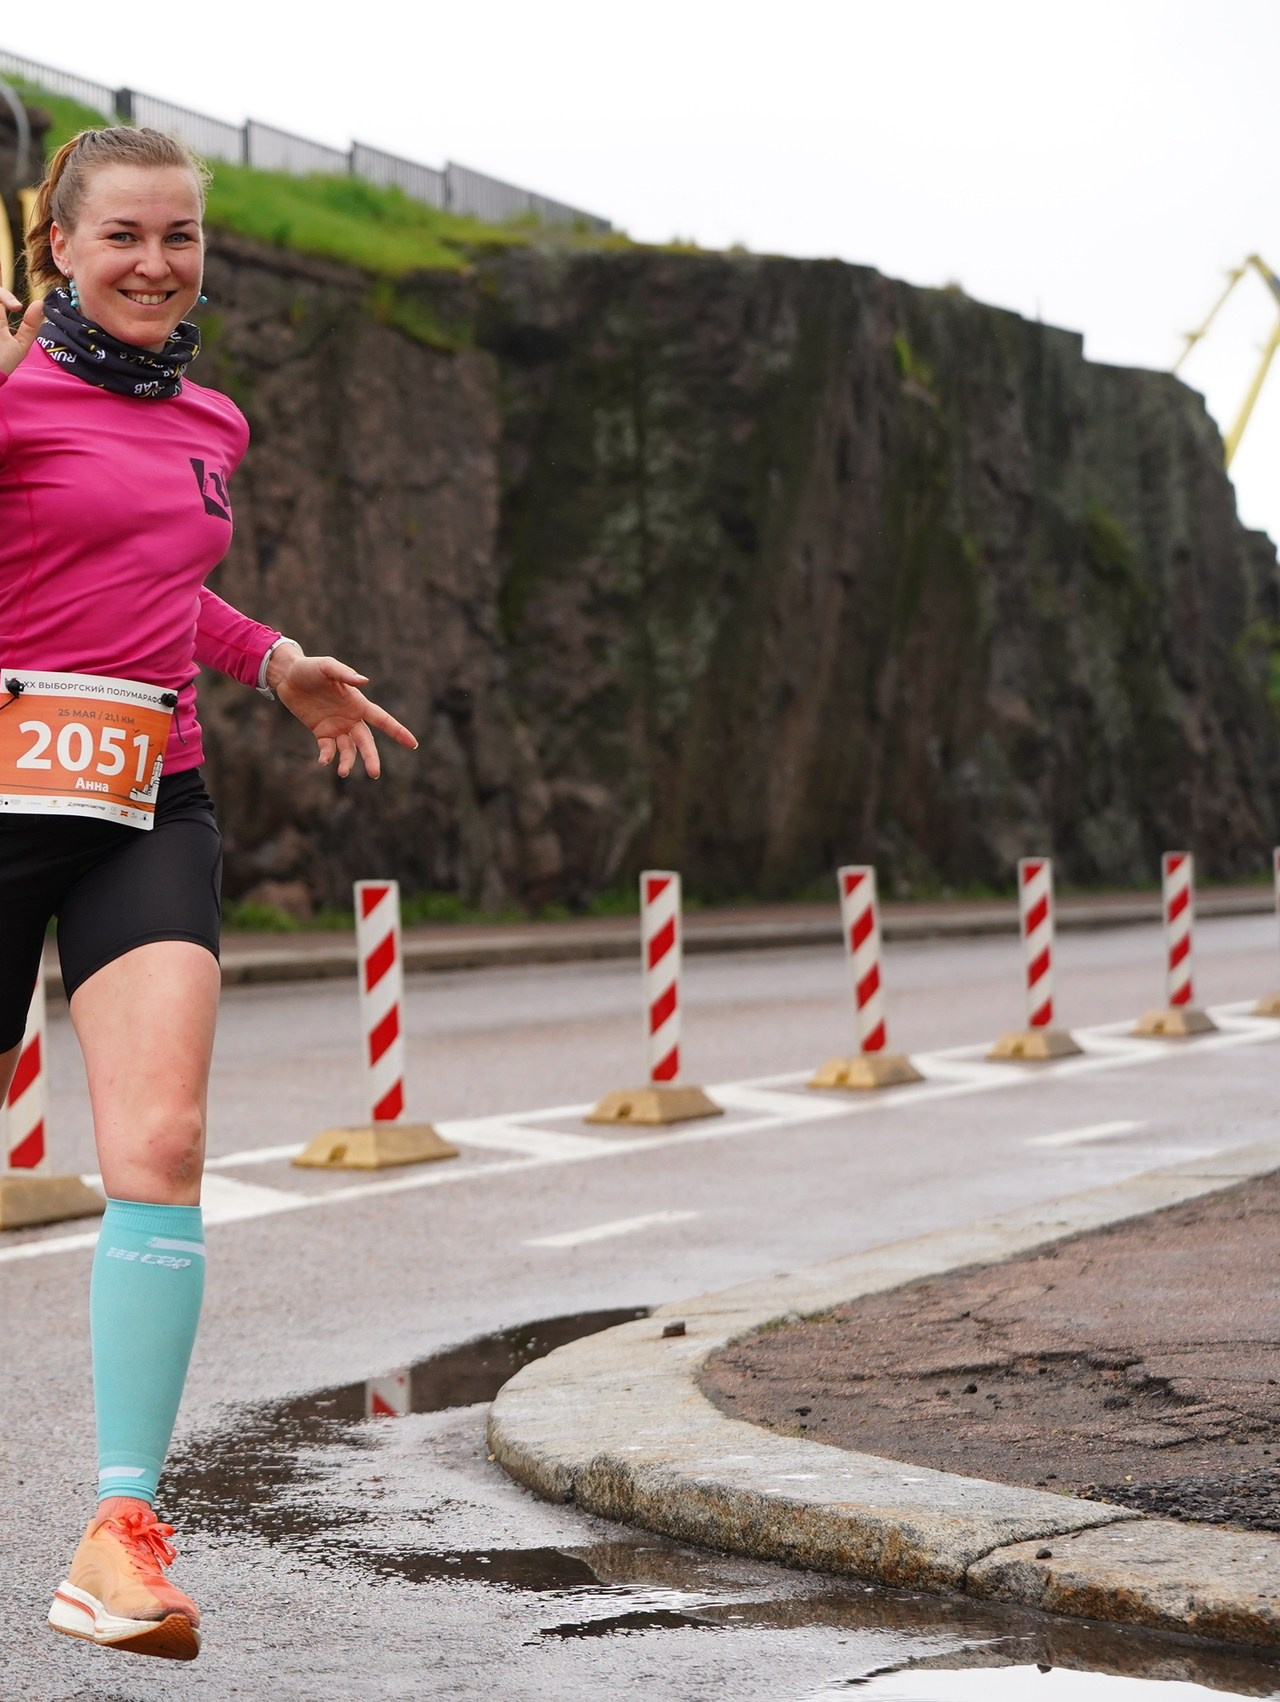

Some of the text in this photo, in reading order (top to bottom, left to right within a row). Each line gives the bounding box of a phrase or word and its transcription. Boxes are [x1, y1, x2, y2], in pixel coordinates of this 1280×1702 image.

[38, 681, 105, 693] ВЫБОРГСКИЙ
[106, 687, 164, 705] ПОЛУМАРАФО
[58, 708, 70, 717] 25
[73, 710, 96, 719] МАЯ
[105, 712, 119, 722] 21,1
[121, 715, 135, 725] КМ
[16, 720, 150, 783] 2051
[75, 776, 109, 793] Анна
